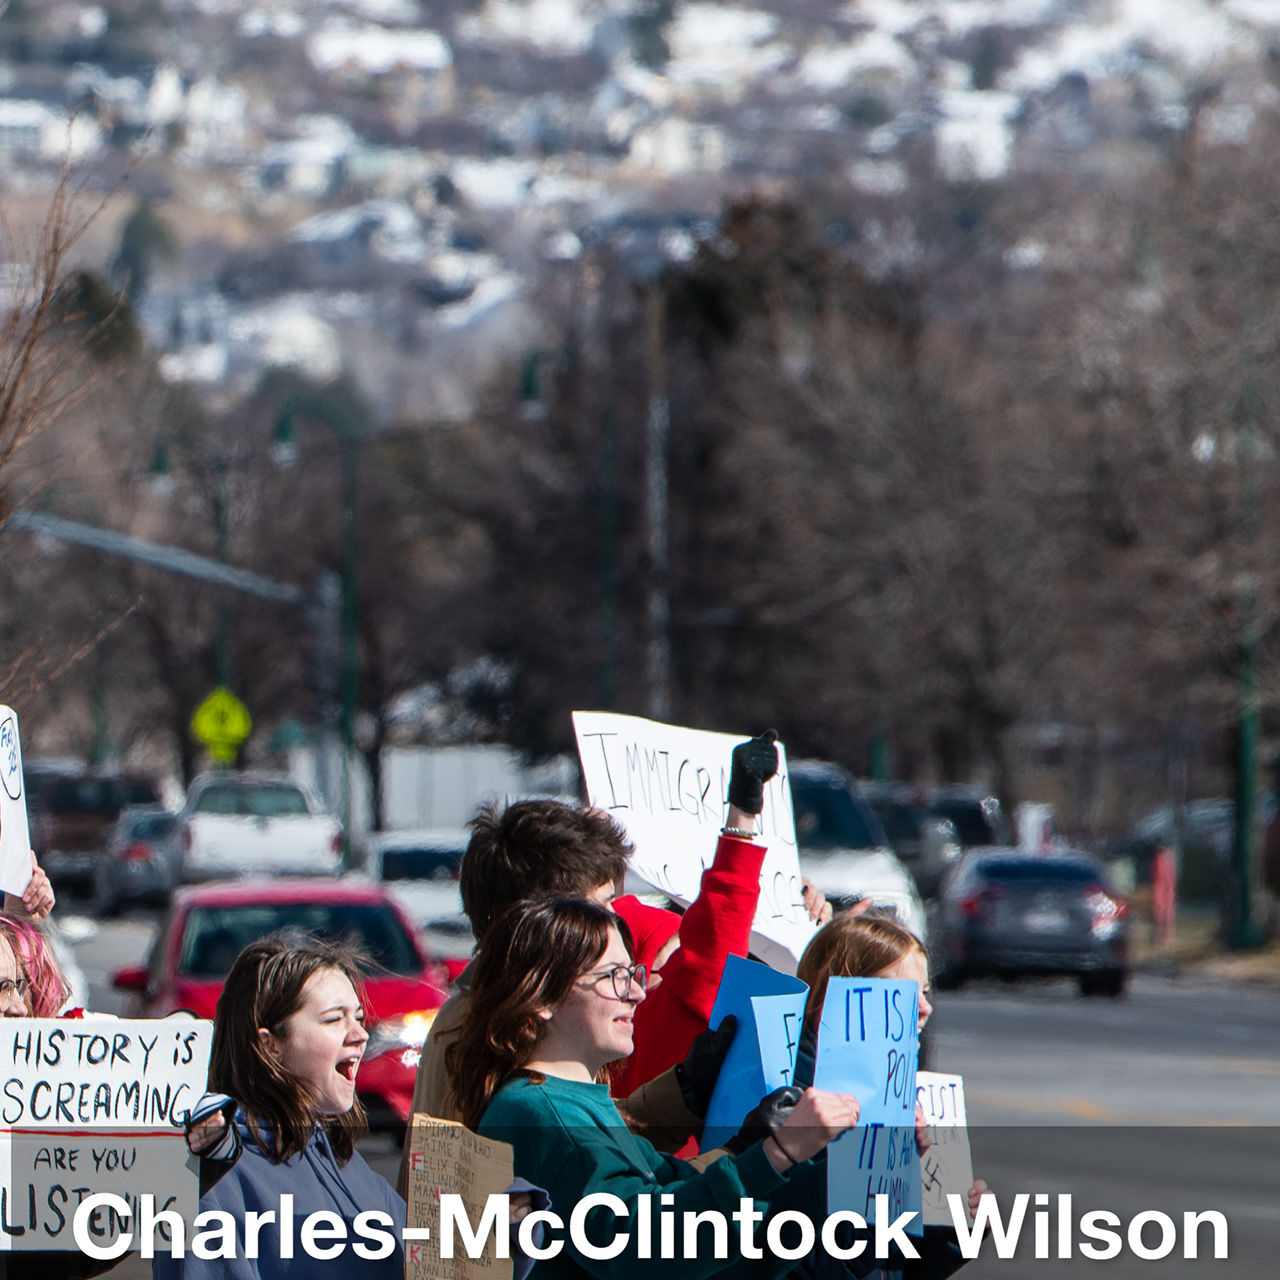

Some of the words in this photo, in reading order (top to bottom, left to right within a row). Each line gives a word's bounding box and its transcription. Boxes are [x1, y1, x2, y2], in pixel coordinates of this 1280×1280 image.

[845, 986, 873, 1042] IT
[884, 988, 905, 1042] IS
[12, 1028, 159, 1077] HISTORY
[1, 1077, 192, 1128] SCREAMING
[34, 1146, 80, 1173] ARE
[92, 1146, 137, 1174] YOU
[411, 1151, 449, 1172] FELIX
[858, 1122, 885, 1170] IT
